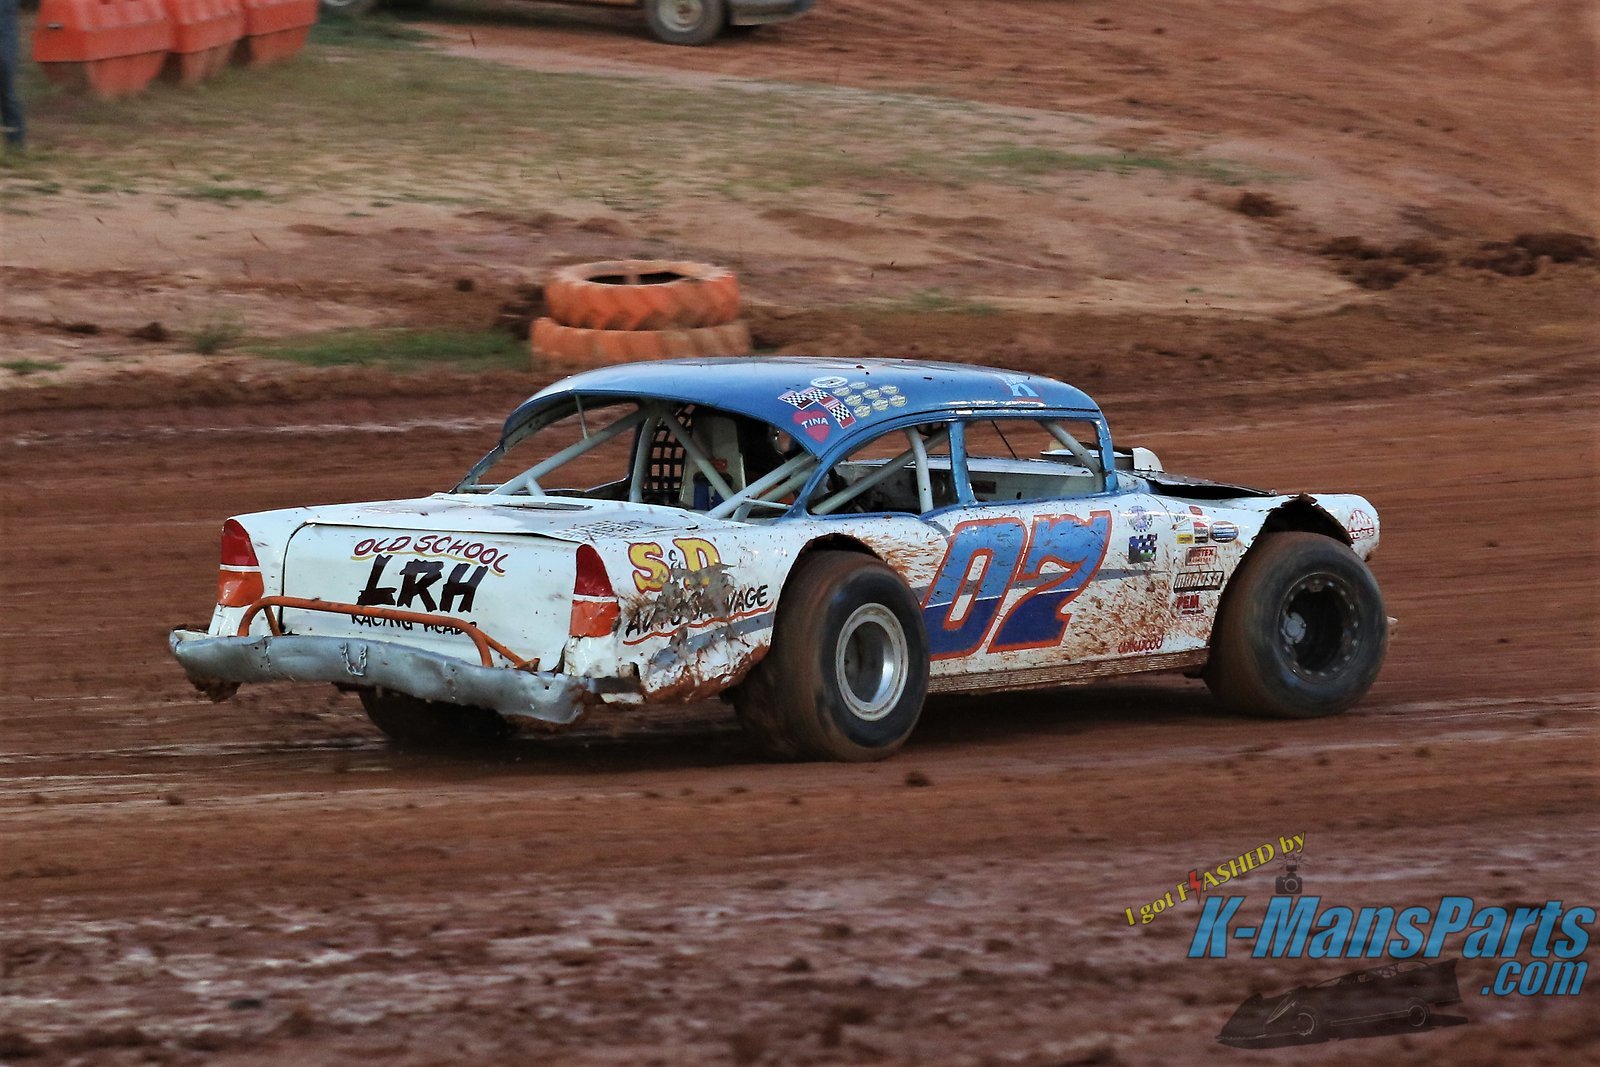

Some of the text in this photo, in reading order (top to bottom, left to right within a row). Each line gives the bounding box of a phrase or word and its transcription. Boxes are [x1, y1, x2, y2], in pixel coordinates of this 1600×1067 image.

[801, 417, 829, 429] TINA
[354, 535, 509, 573] OLD SCHOOL
[356, 553, 489, 613] LRH
[921, 510, 1112, 661] 07
